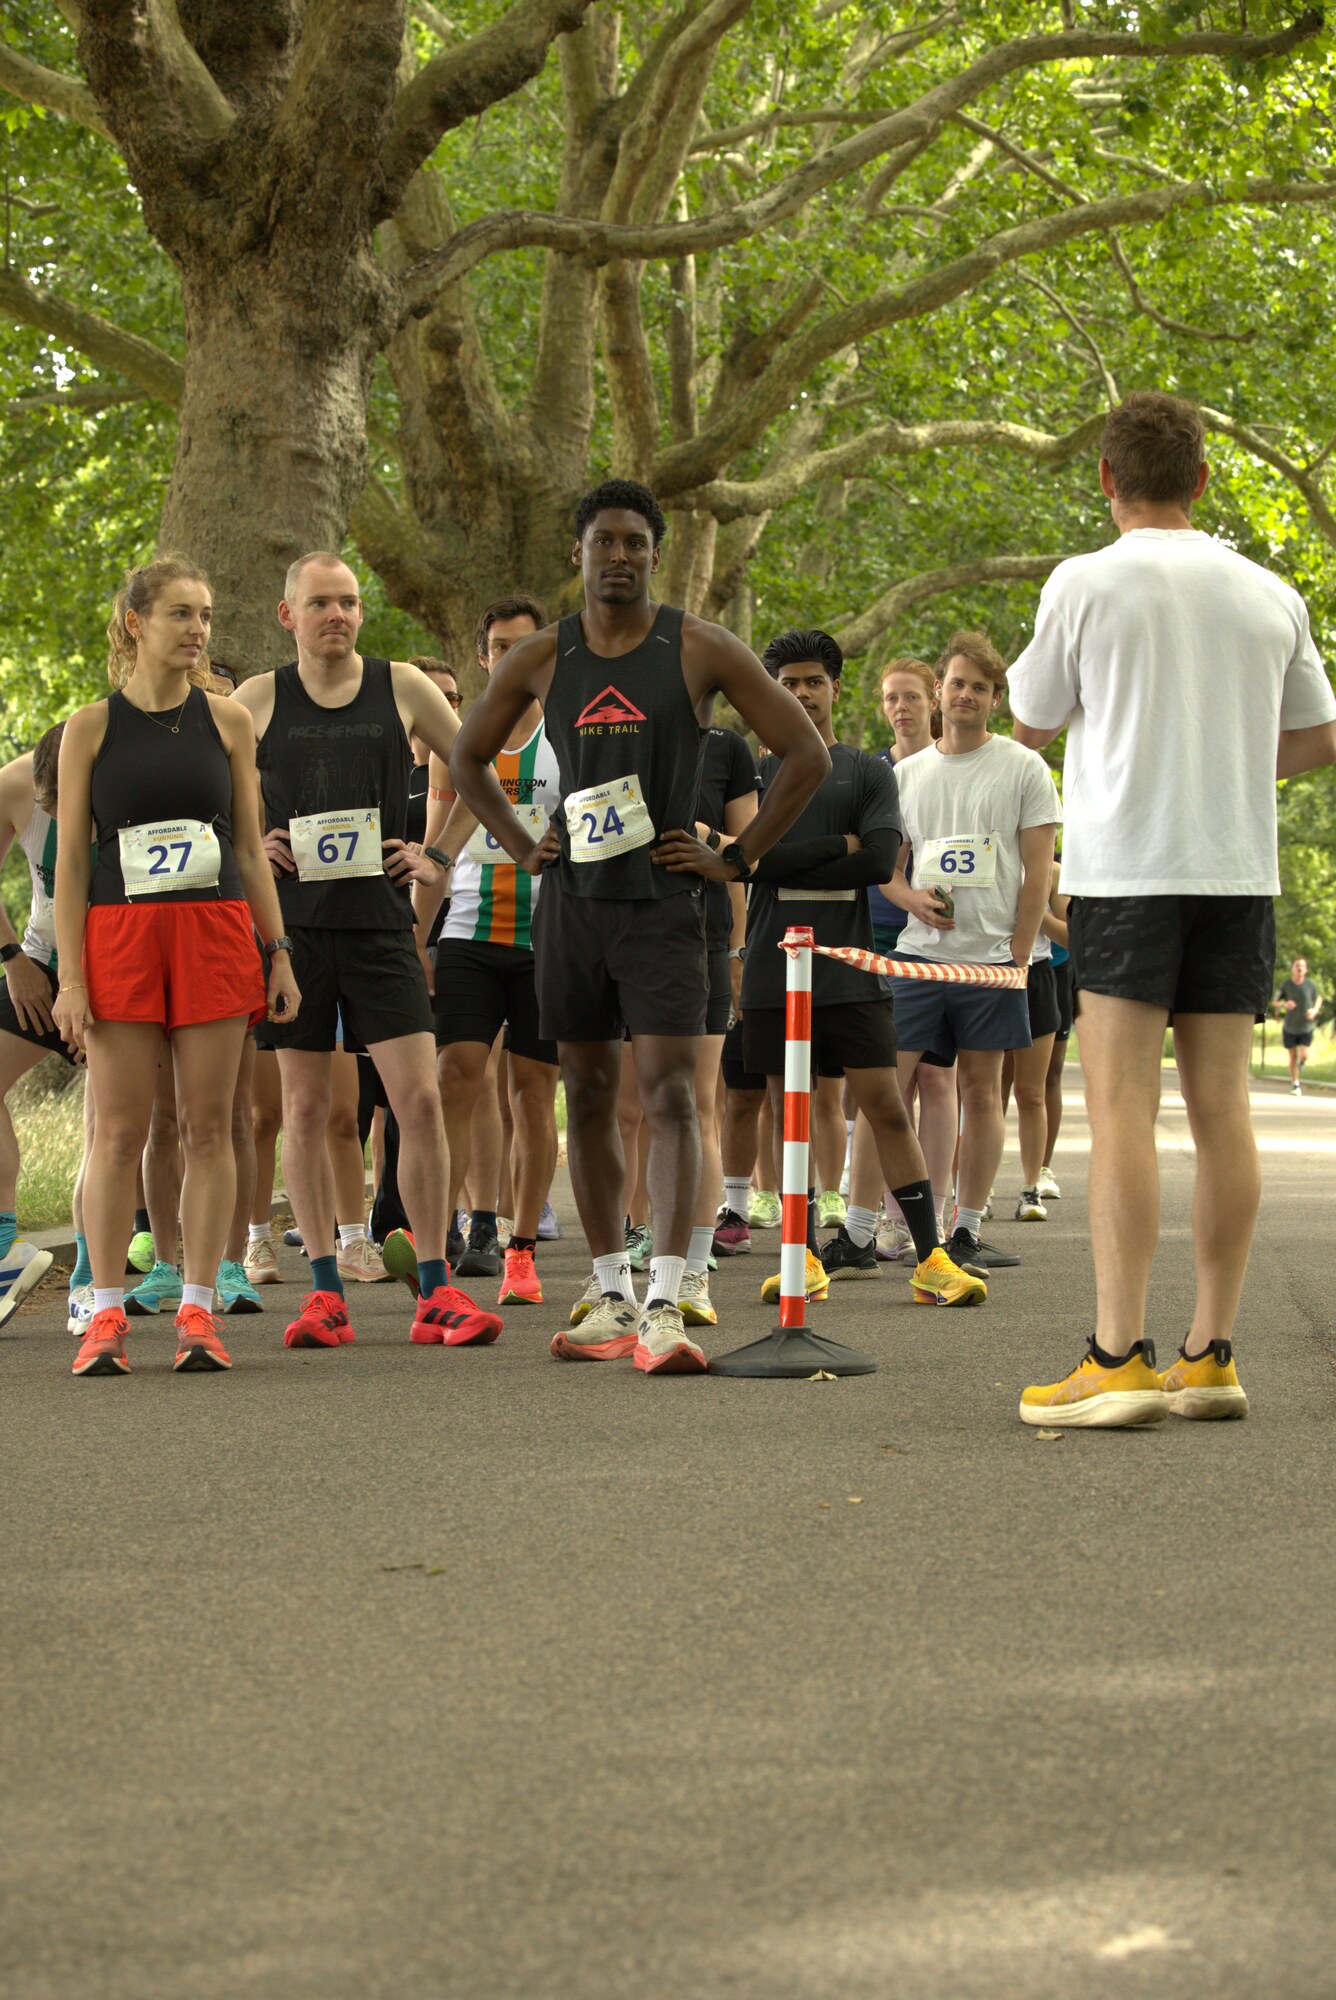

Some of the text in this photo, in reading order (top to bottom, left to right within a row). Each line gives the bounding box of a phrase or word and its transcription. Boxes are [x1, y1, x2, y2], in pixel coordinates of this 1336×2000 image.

[346, 722, 384, 739] MIND
[580, 724, 640, 737] NIKE TRAIL
[317, 816, 354, 825] AFFORDABLE
[321, 823, 351, 831] RUNNING
[581, 805, 625, 844] 24
[147, 825, 188, 836] AFFORDABLE
[152, 834, 184, 842] RUNNING
[317, 831, 359, 864] 67
[147, 841, 193, 876] 27
[940, 850, 975, 874] 63
